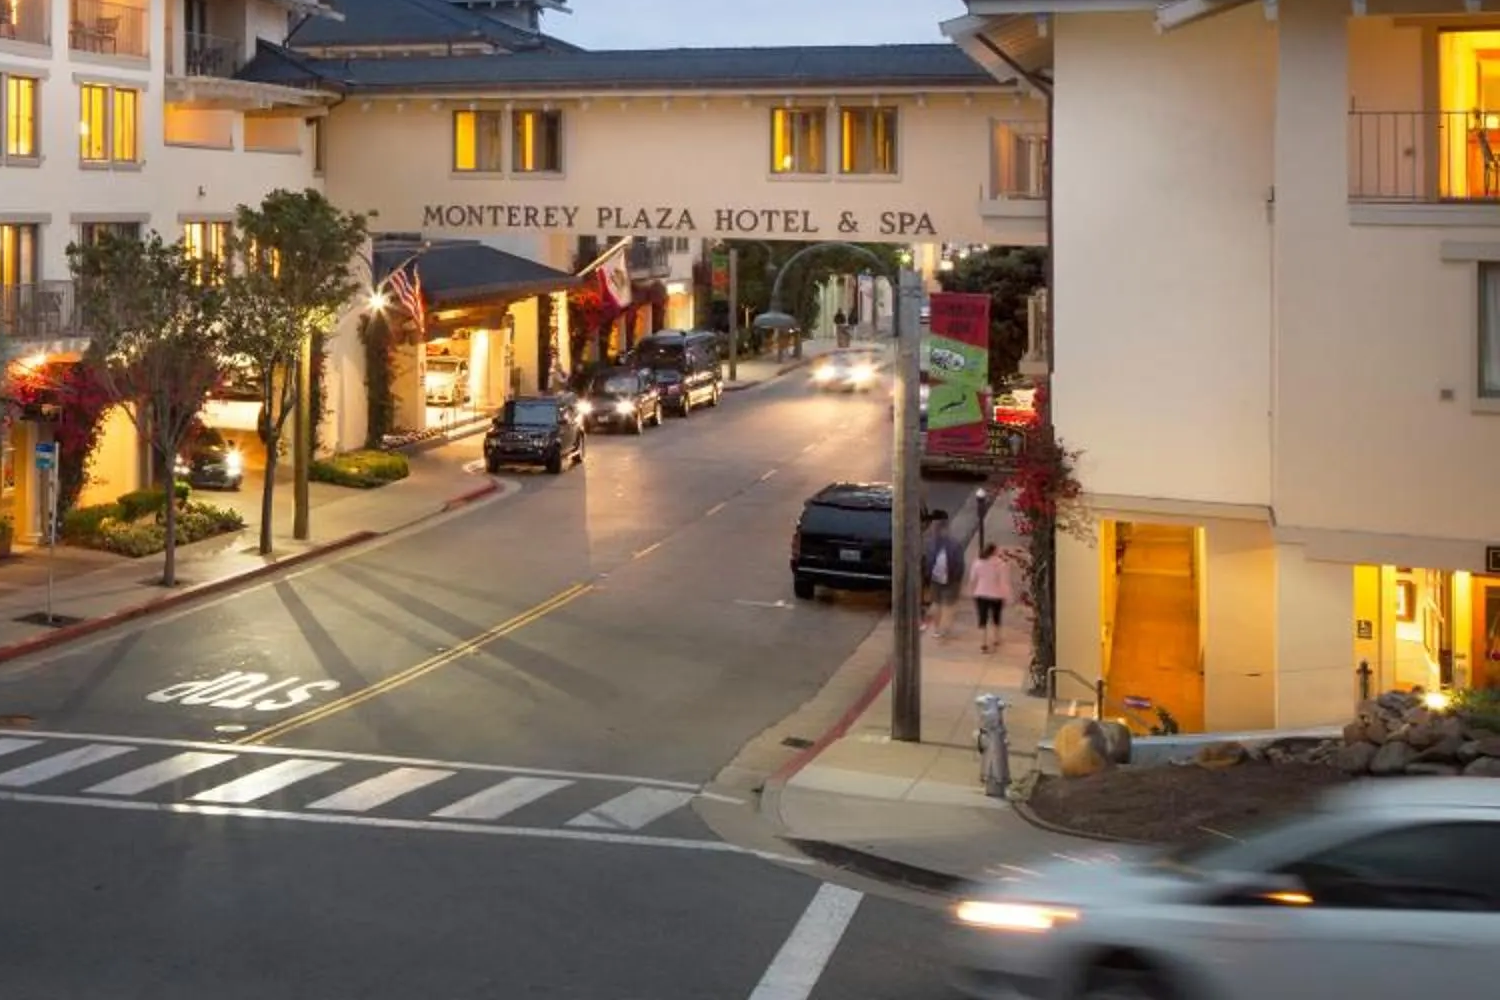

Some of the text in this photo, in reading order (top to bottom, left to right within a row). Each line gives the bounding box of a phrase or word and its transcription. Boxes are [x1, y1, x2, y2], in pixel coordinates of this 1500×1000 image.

[422, 204, 937, 235] MONTEREY PLAZA HOTEL & SPA
[145, 671, 341, 711] STOP
